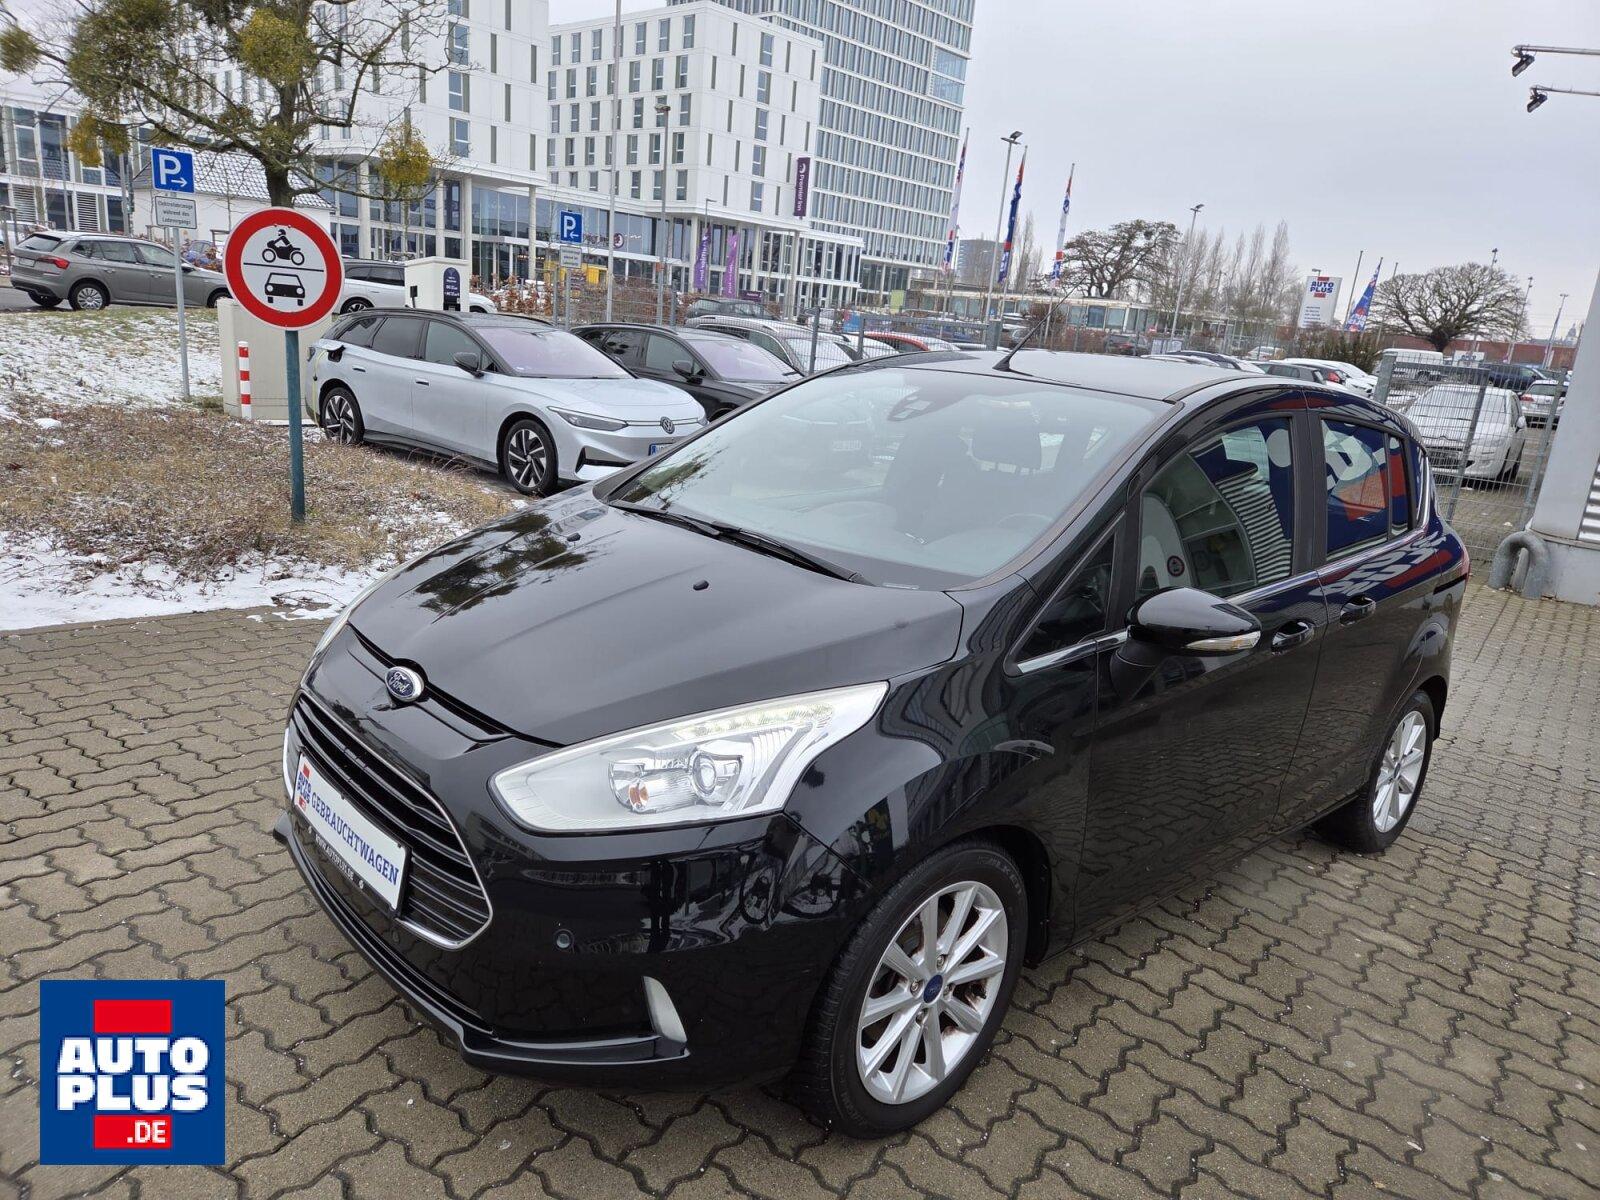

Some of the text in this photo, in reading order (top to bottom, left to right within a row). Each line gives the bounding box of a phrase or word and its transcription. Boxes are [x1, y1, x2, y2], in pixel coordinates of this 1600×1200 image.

[159, 153, 181, 186] P
[563, 214, 577, 239] P
[388, 671, 411, 694] Ford
[311, 792, 400, 886] GEBRAUCHTWAGEN
